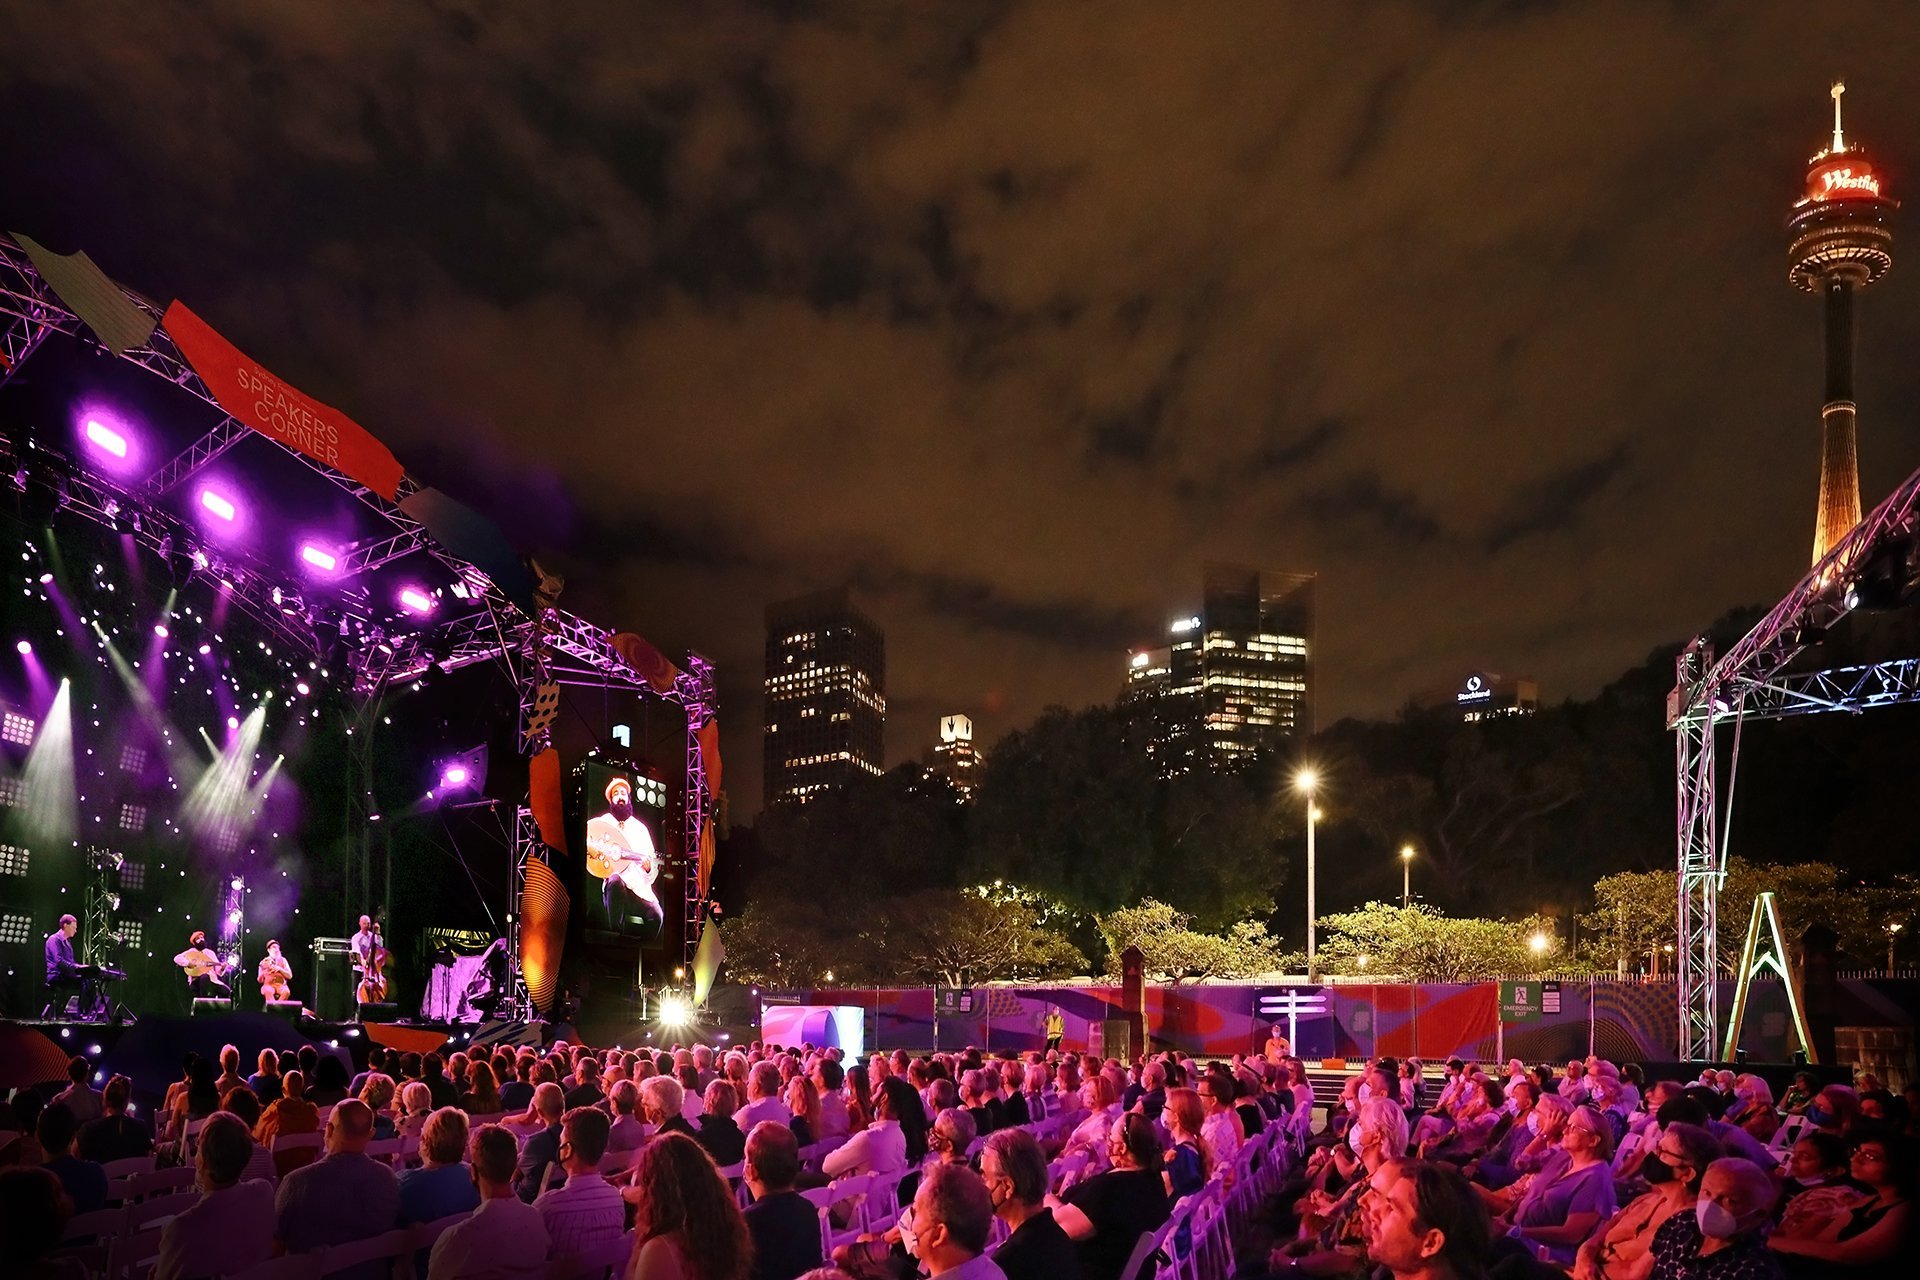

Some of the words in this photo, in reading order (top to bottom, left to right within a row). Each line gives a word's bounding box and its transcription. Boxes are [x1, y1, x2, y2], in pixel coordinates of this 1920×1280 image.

[238, 368, 338, 444] SPEAKERS
[255, 401, 338, 466] CORNER
[1457, 688, 1490, 701] Stockland
[1503, 1004, 1539, 1012] EMERGENCY
